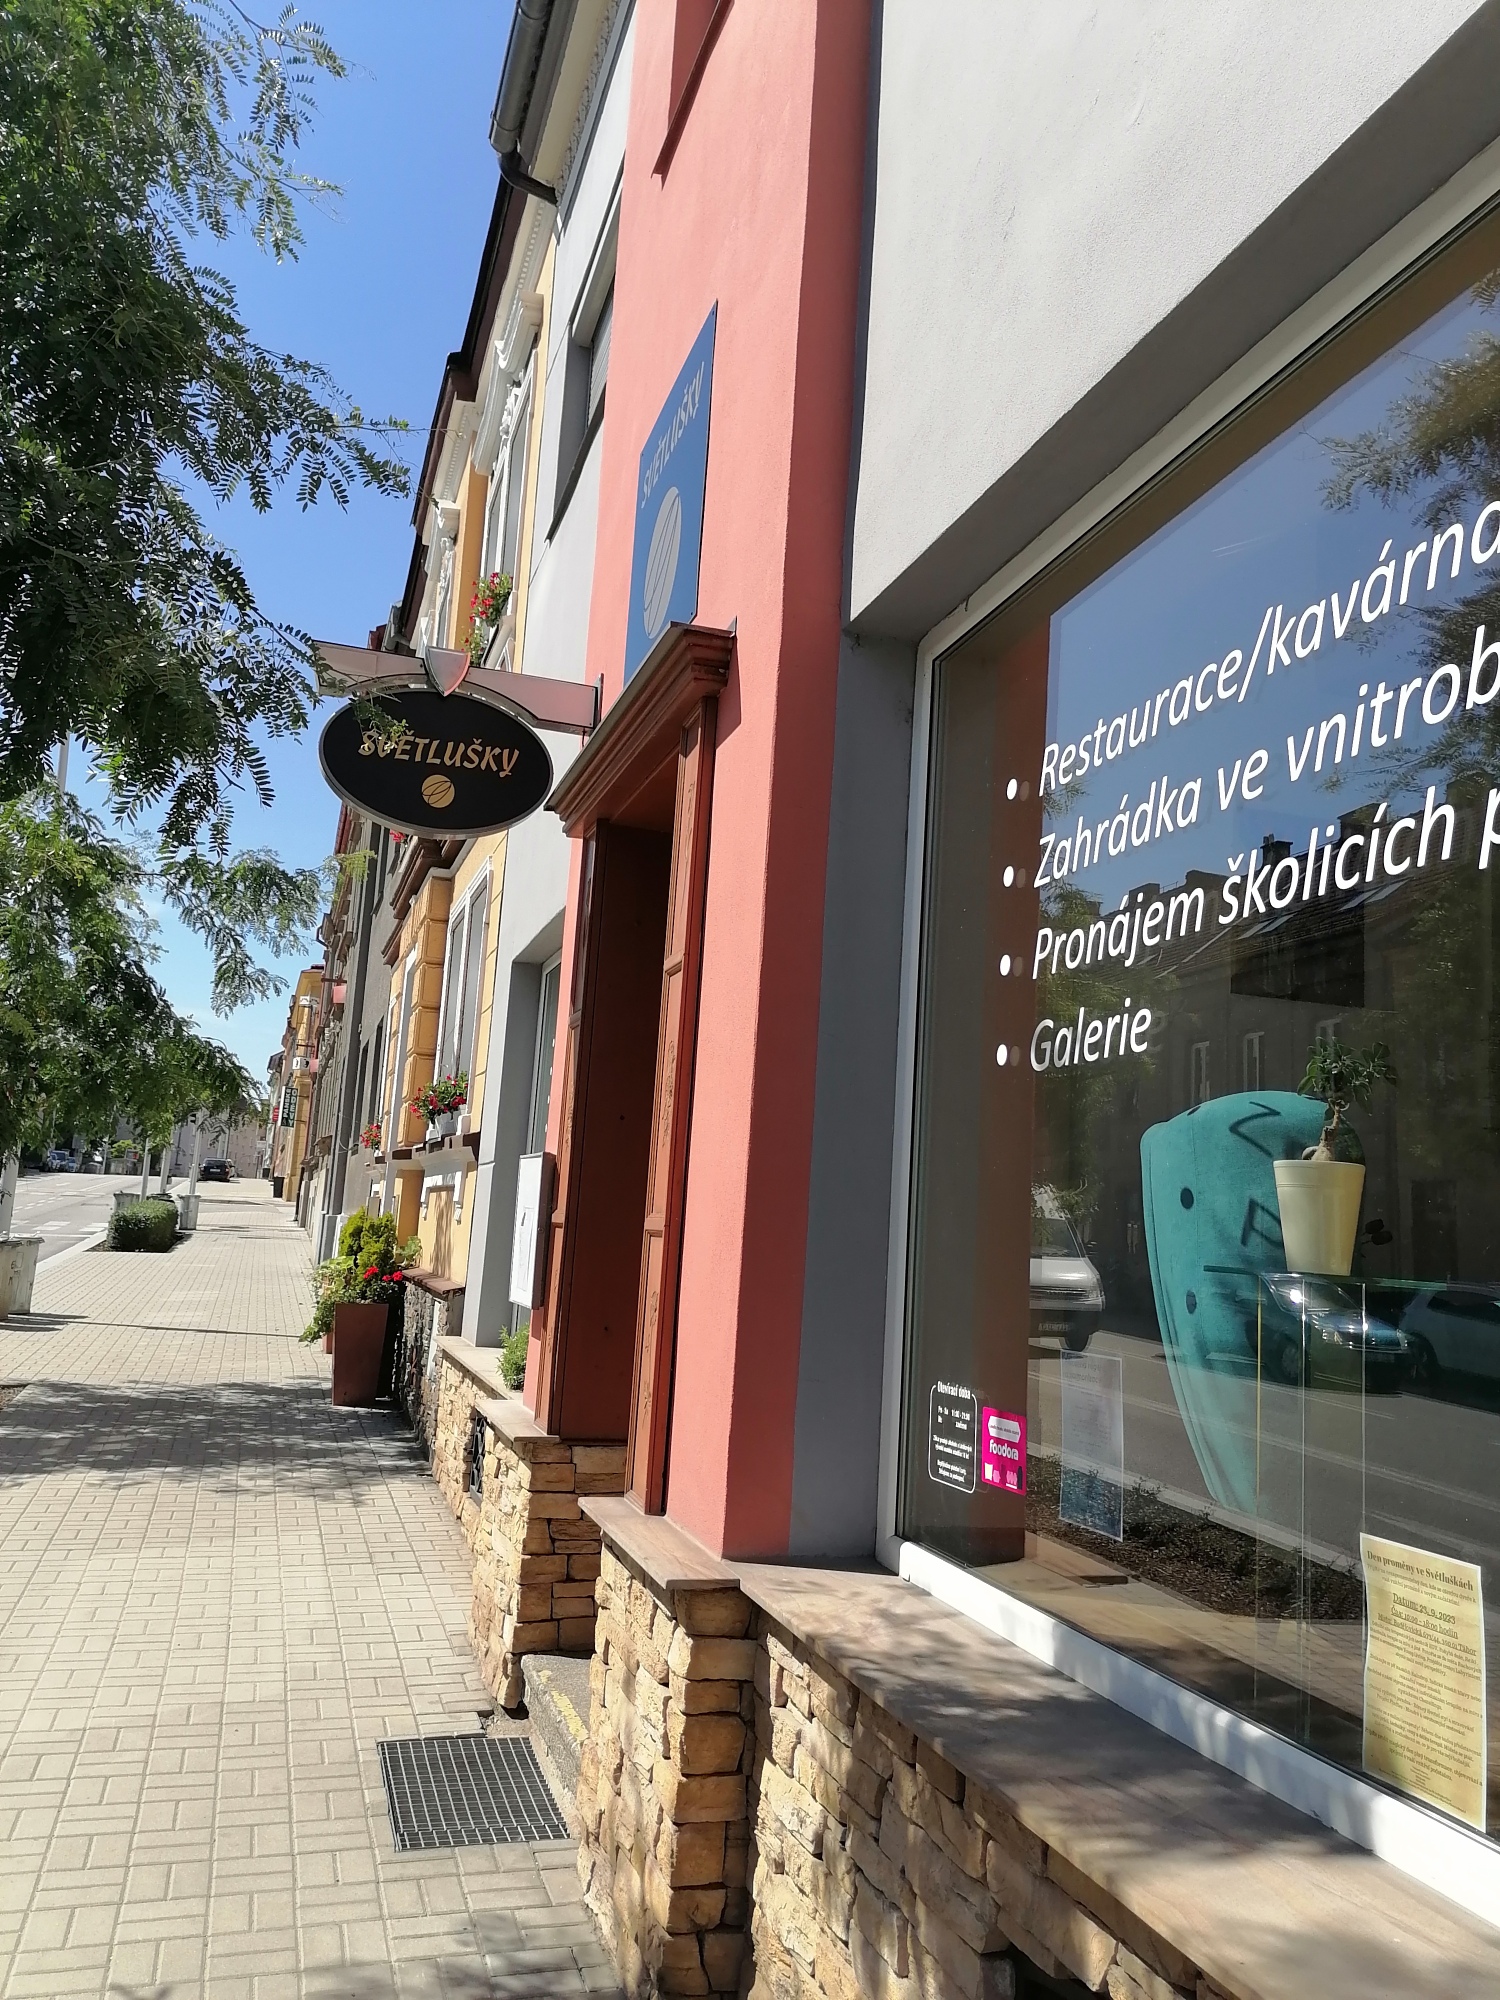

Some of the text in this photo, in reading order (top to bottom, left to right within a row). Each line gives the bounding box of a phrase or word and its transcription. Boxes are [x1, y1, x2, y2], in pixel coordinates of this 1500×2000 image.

[1033, 625, 1500, 889] Zahrádka ve vnitrob
[1032, 885, 1204, 981] Pronájem
[1218, 785, 1453, 925] školicích
[1029, 998, 1153, 1073] Galerie
[989, 1439, 1018, 1460] foodora
[1367, 1550, 1382, 1562] Den
[1382, 1556, 1415, 1575] proměny
[1416, 1566, 1425, 1576] ve
[1425, 1567, 1474, 1591] Světluškách
